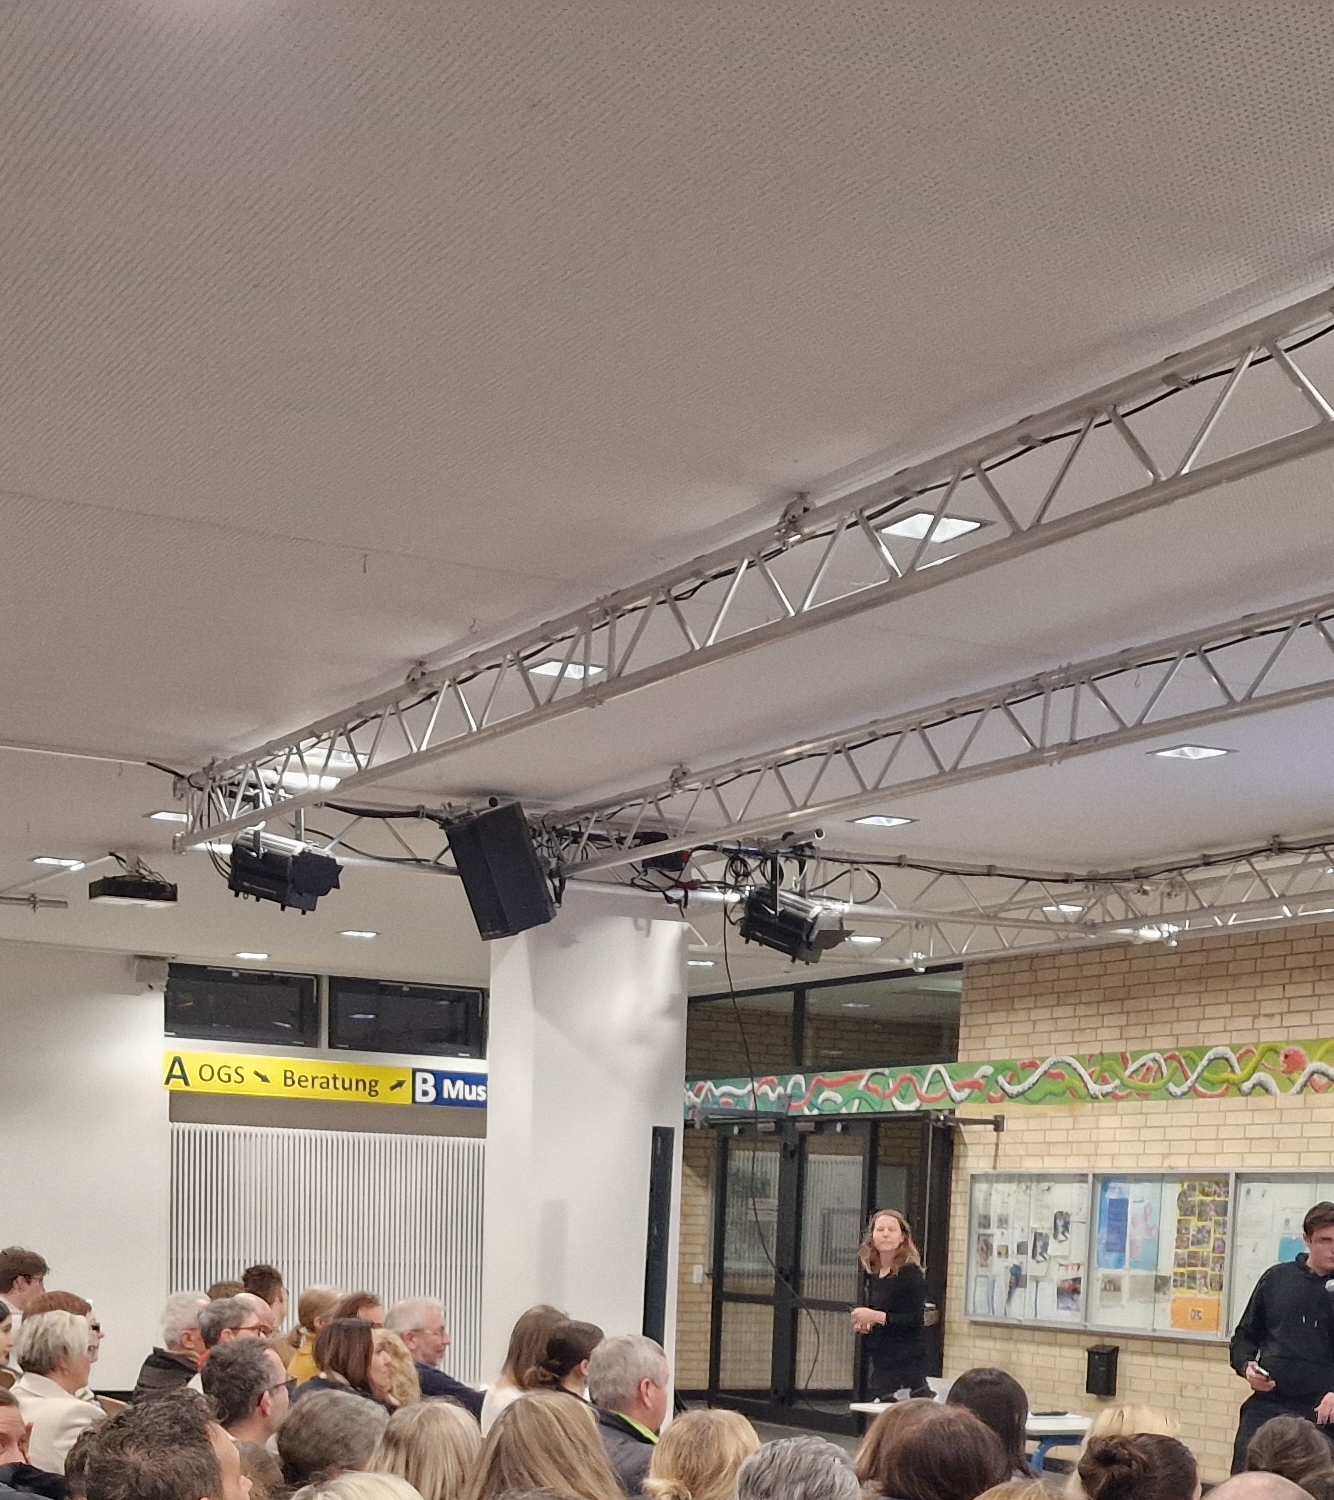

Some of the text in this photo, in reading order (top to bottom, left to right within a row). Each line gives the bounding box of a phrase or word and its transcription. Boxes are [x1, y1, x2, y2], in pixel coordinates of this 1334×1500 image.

[164, 1056, 380, 1097] A OGS Beratung
[415, 1071, 487, 1103] B Mus
